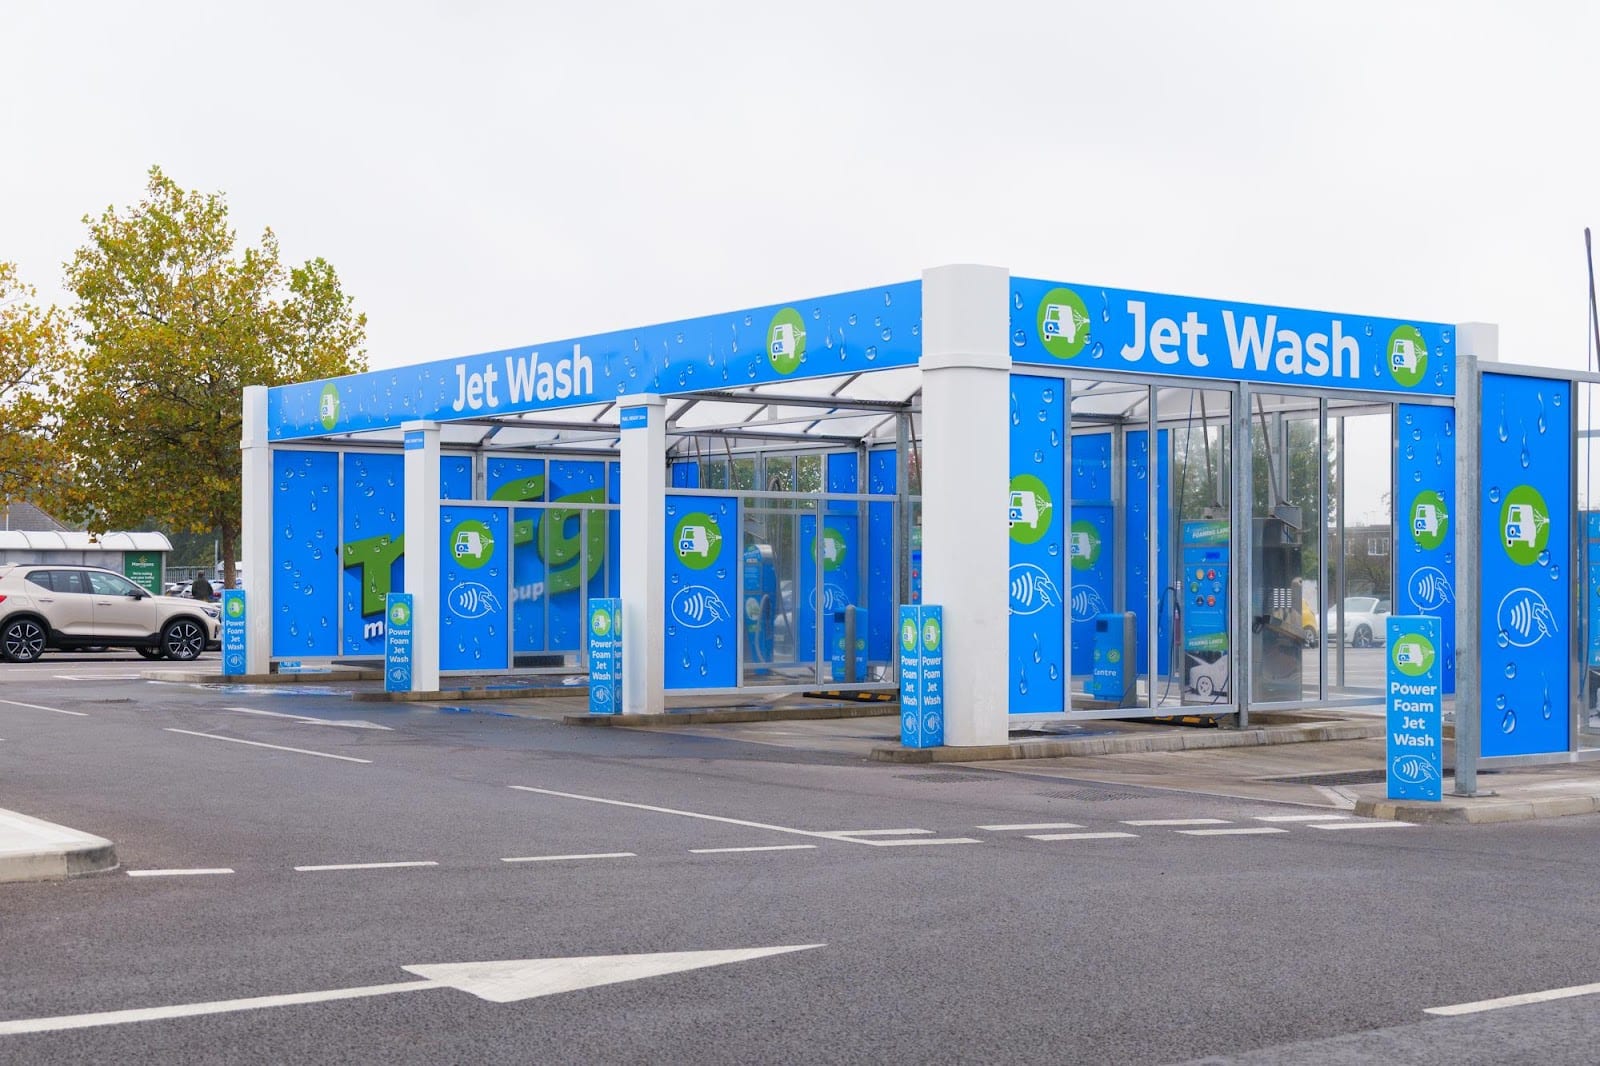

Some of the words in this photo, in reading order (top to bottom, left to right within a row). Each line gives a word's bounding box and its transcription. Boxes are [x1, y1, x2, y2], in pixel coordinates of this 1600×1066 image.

[1120, 300, 1209, 367] Jet
[1221, 310, 1360, 379] Wash
[452, 363, 499, 412] Jet
[505, 344, 593, 404] Wash
[388, 628, 411, 636] Power
[389, 637, 409, 645] Foam
[590, 640, 612, 648] Power
[592, 650, 611, 659] Foam
[595, 661, 607, 670] Jet
[901, 655, 918, 666] Power
[922, 656, 941, 666] Power
[592, 672, 611, 681] Wash
[902, 669, 917, 679] Foam
[923, 669, 941, 679] Foam
[905, 682, 914, 692] Jet
[927, 682, 938, 692] Jet
[1390, 682, 1437, 695] Power
[902, 695, 918, 706] Wash
[923, 695, 941, 706] Wash
[1393, 699, 1434, 712] Foam
[1401, 716, 1426, 729] Jet
[1393, 733, 1435, 747] Wash
